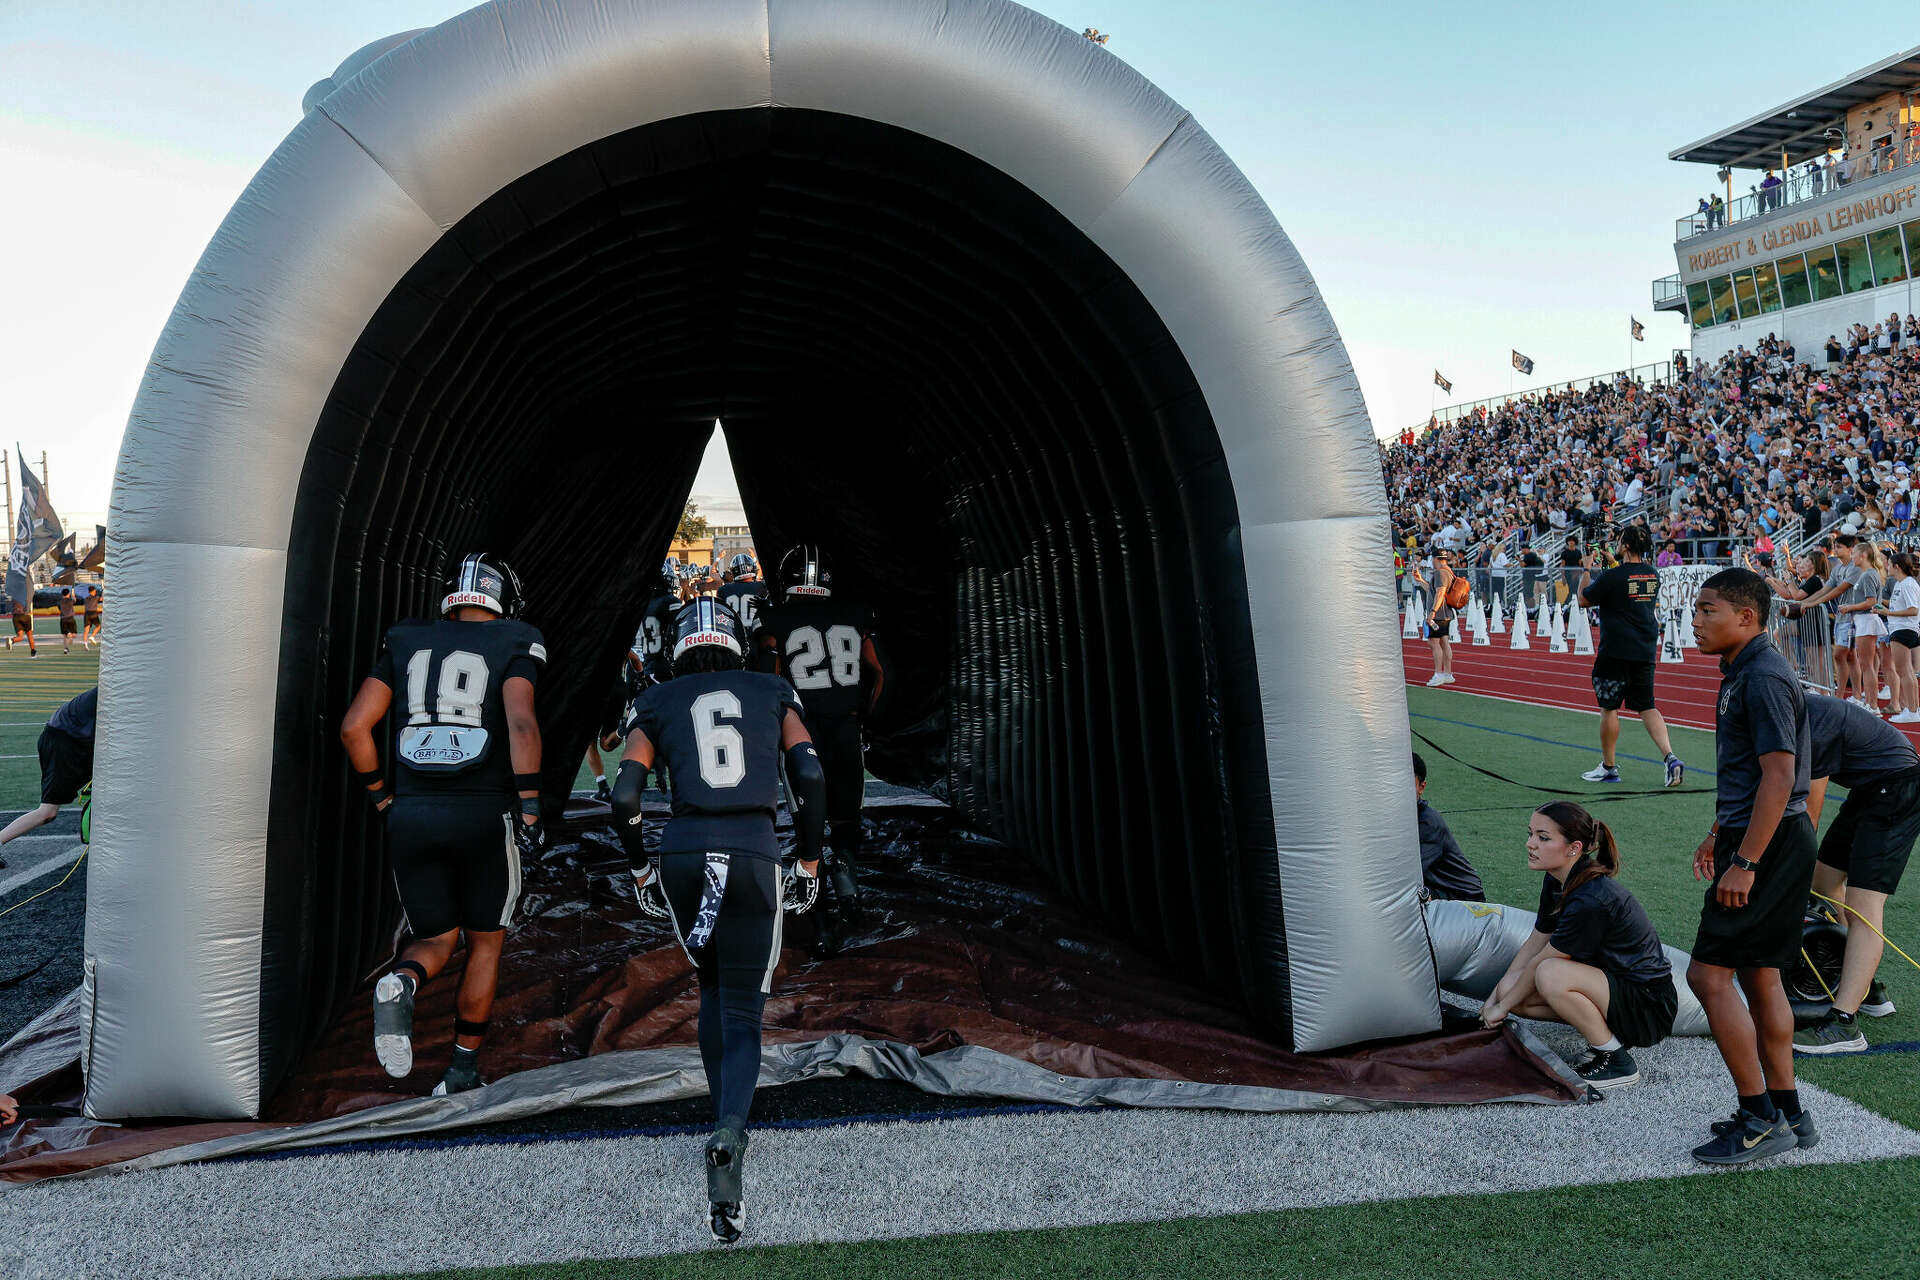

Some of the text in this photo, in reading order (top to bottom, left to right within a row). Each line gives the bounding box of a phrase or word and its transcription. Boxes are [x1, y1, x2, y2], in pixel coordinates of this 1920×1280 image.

[1688, 184, 1917, 272] ROBERT & GLENDA LEHNHOFF
[447, 593, 486, 605] Riddell
[796, 586, 826, 595] Riddell
[685, 633, 728, 646] Riddell
[785, 624, 862, 690] 28
[406, 649, 490, 727] 18
[690, 689, 746, 789] 6
